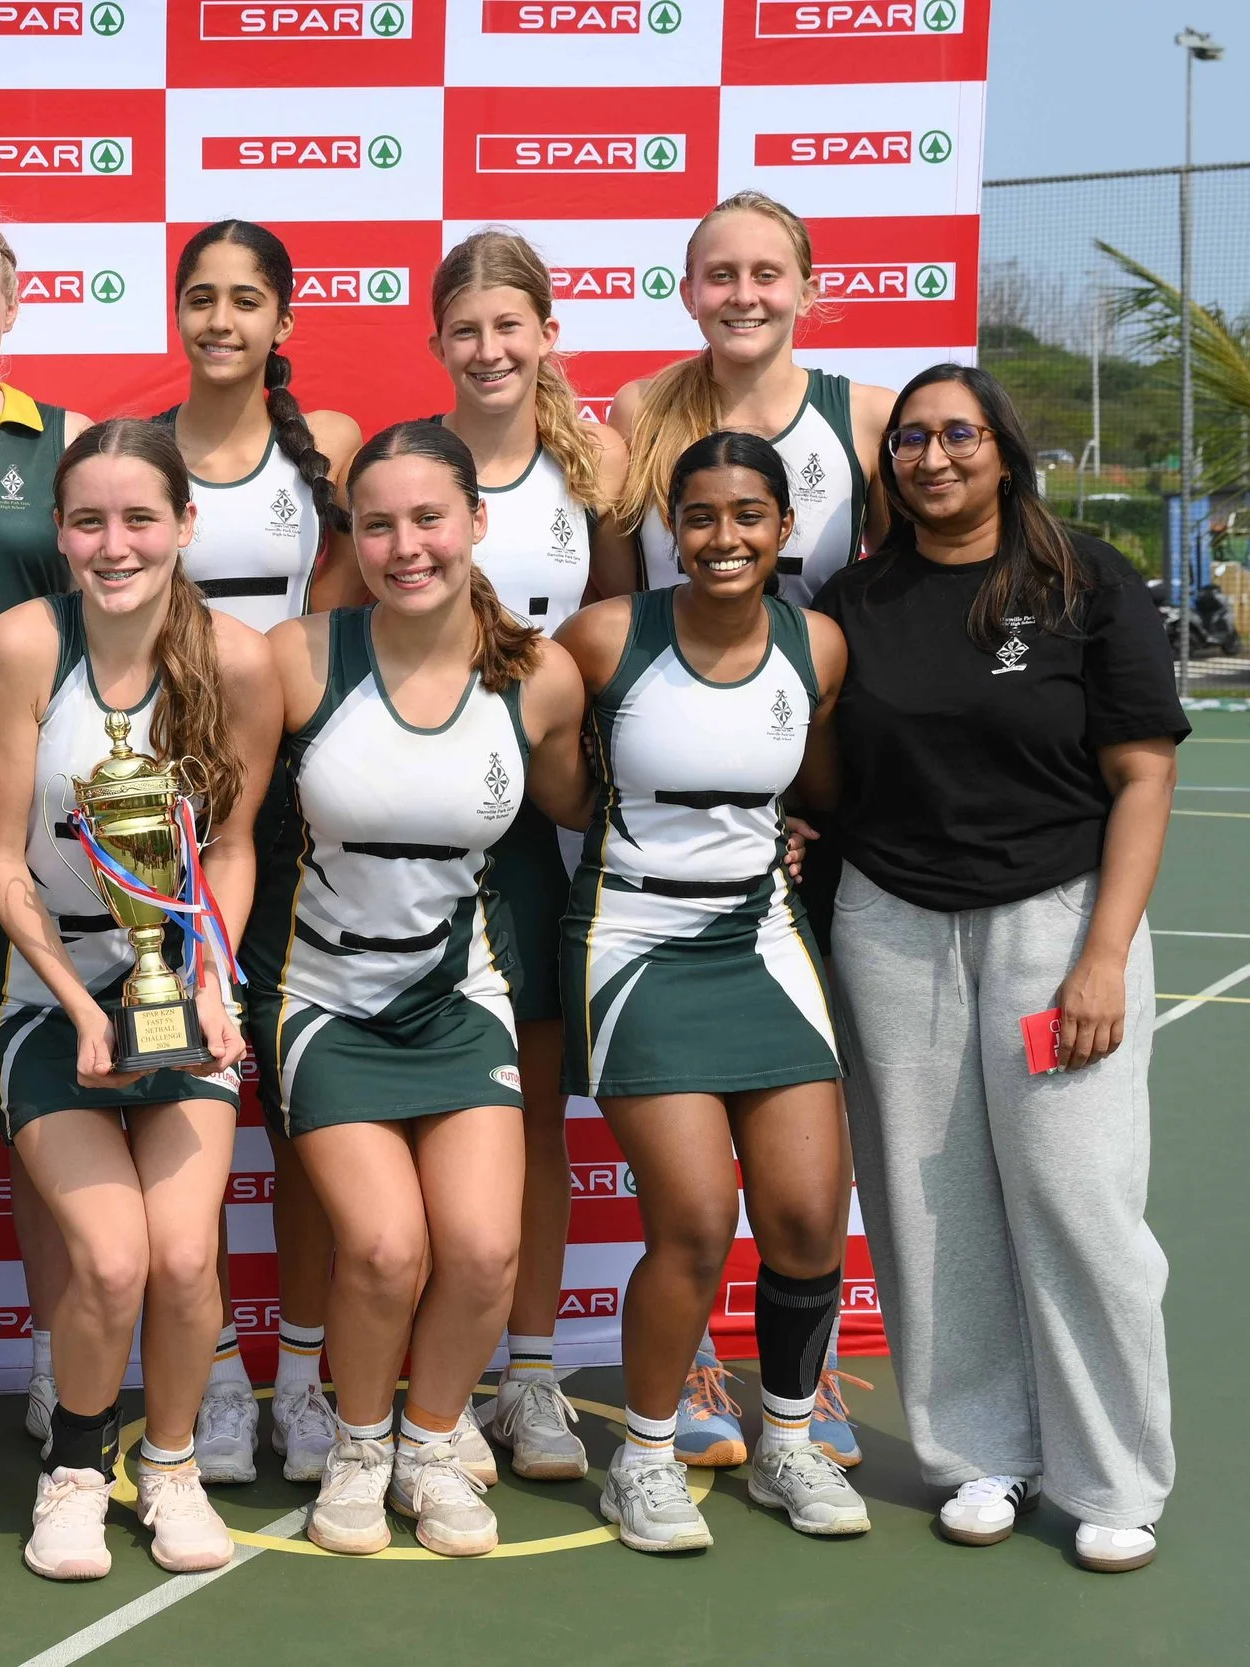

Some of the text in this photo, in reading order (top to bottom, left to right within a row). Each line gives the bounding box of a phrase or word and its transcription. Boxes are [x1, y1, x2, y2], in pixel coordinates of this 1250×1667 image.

[240, 8, 360, 32] SPAR
[519, 5, 637, 29] SPAR
[795, 4, 913, 30] SPAR
[239, 141, 358, 165] SPAR
[515, 142, 634, 165] SPAR
[791, 136, 909, 161] SPAR
[20, 275, 81, 299] AR
[293, 275, 357, 298] AR
[550, 271, 632, 295] PAR
[818, 271, 905, 295] PAR
[142, 1008, 175, 1019] SPAR KZN
[146, 1018, 164, 1026] FAST
[140, 1032, 183, 1043] CHALLENGE
[145, 1025, 176, 1034] NETBALL
[558, 1293, 615, 1315] AR
